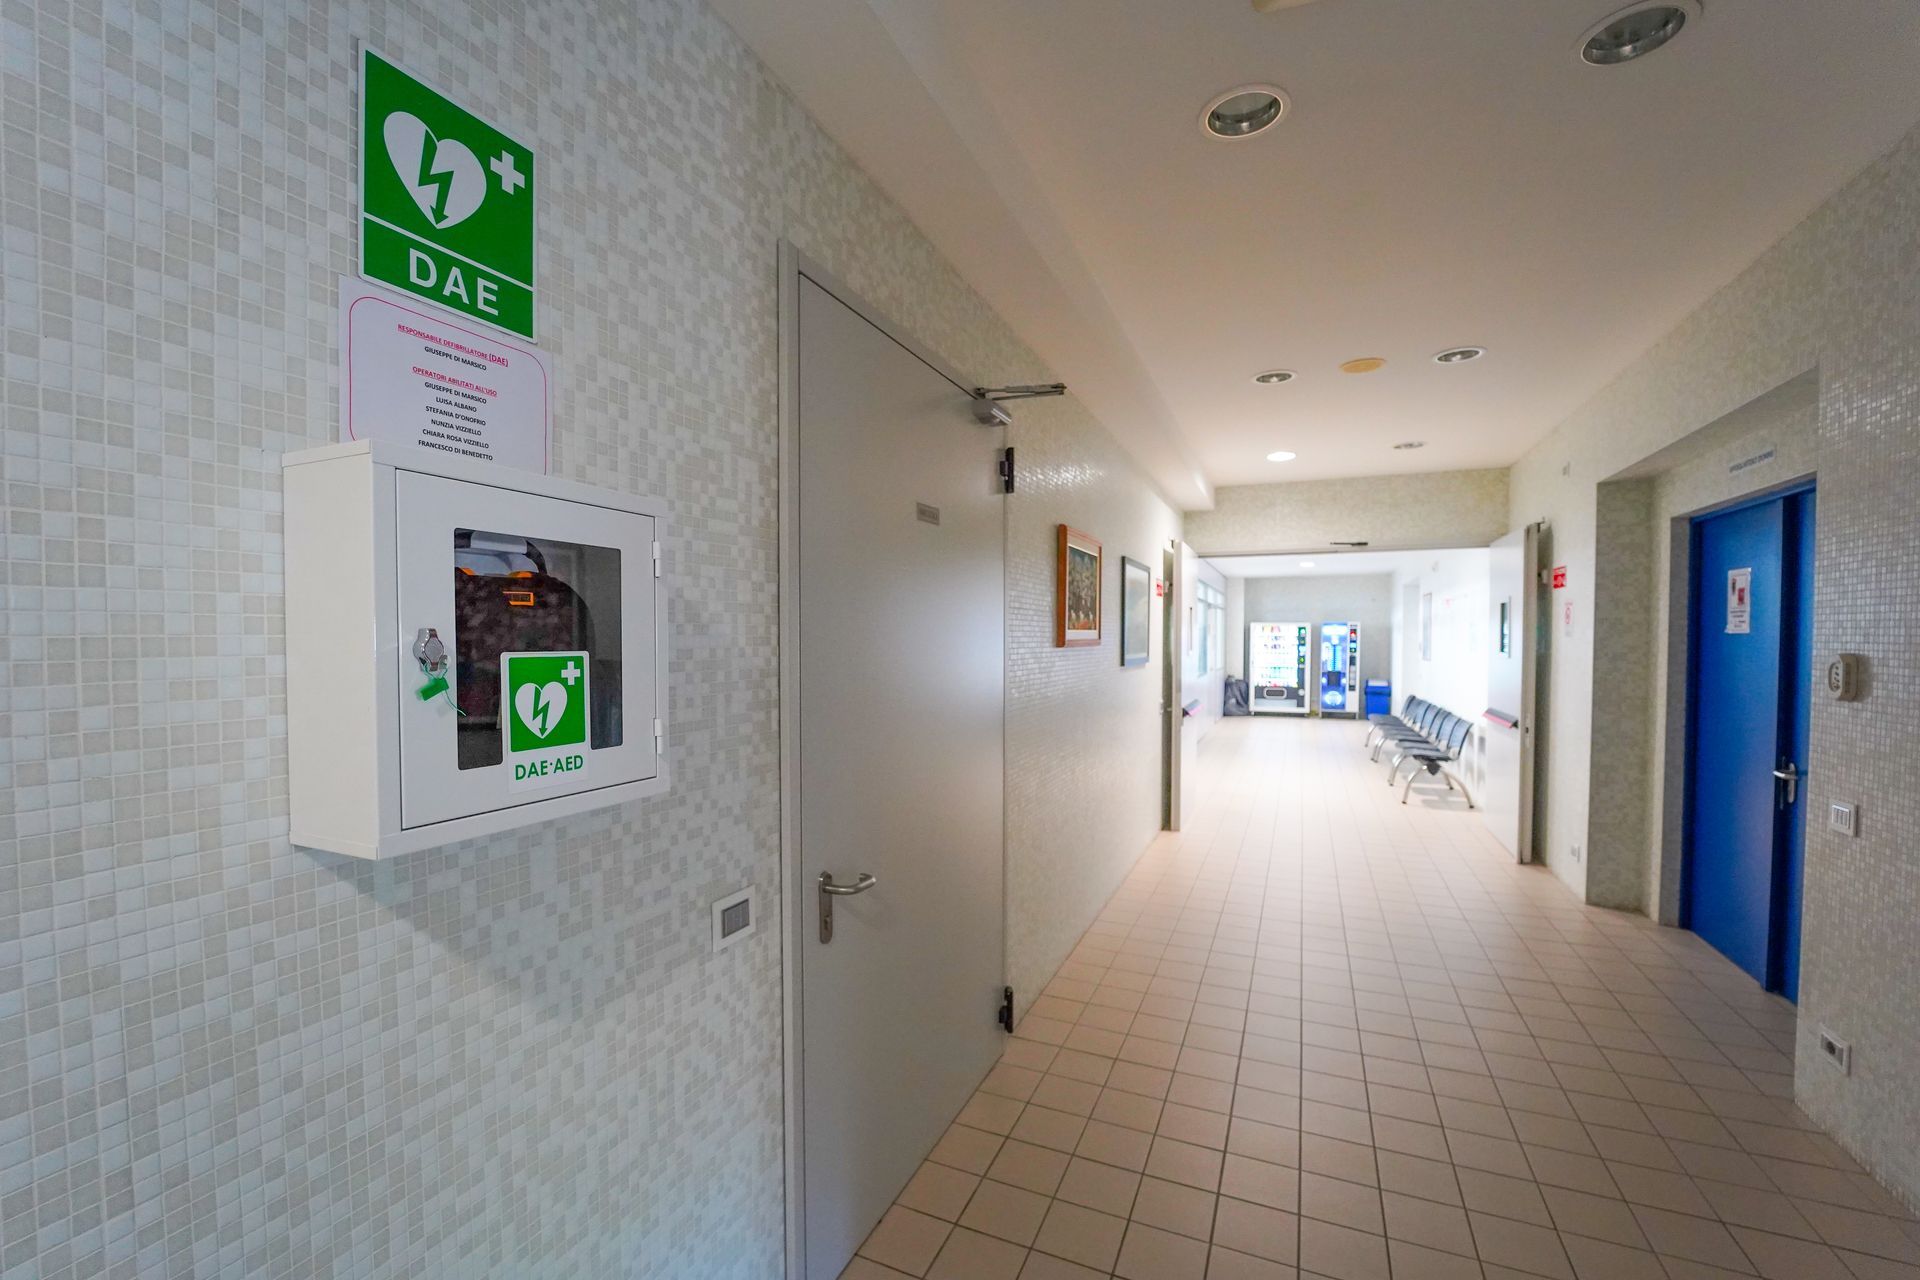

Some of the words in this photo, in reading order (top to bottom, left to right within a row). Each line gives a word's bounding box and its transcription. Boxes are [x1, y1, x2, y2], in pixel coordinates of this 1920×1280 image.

[409, 247, 499, 316] DAE
[398, 324, 442, 345] RESPONSABILE
[444, 340, 487, 359] DEFIBRILLATORE
[489, 353, 508, 368] (DAE)
[425, 346, 452, 360] GIUSEPPE
[461, 358, 487, 371] MARSICO
[412, 366, 446, 381] OPERATORI
[448, 377, 474, 389] ABILITATI
[475, 385, 498, 397] ALL'USO
[425, 382, 452, 394] GIUSEPPE
[462, 392, 487, 404] MARSICO
[436, 397, 453, 406] LUISA
[454, 402, 477, 412] ALBANO
[425, 405, 454, 418] STEFANIA
[455, 413, 486, 426] D'ONOFRIO
[431, 419, 454, 429] NUNZIA
[455, 425, 482, 436] VIZZIELLO
[422, 428, 445, 439] CHIARA
[446, 434, 462, 443] ROSA
[463, 438, 489, 449] VIZZIELLO
[418, 440, 453, 452] FRANCESCO
[462, 449, 493, 461] BENEDETTO
